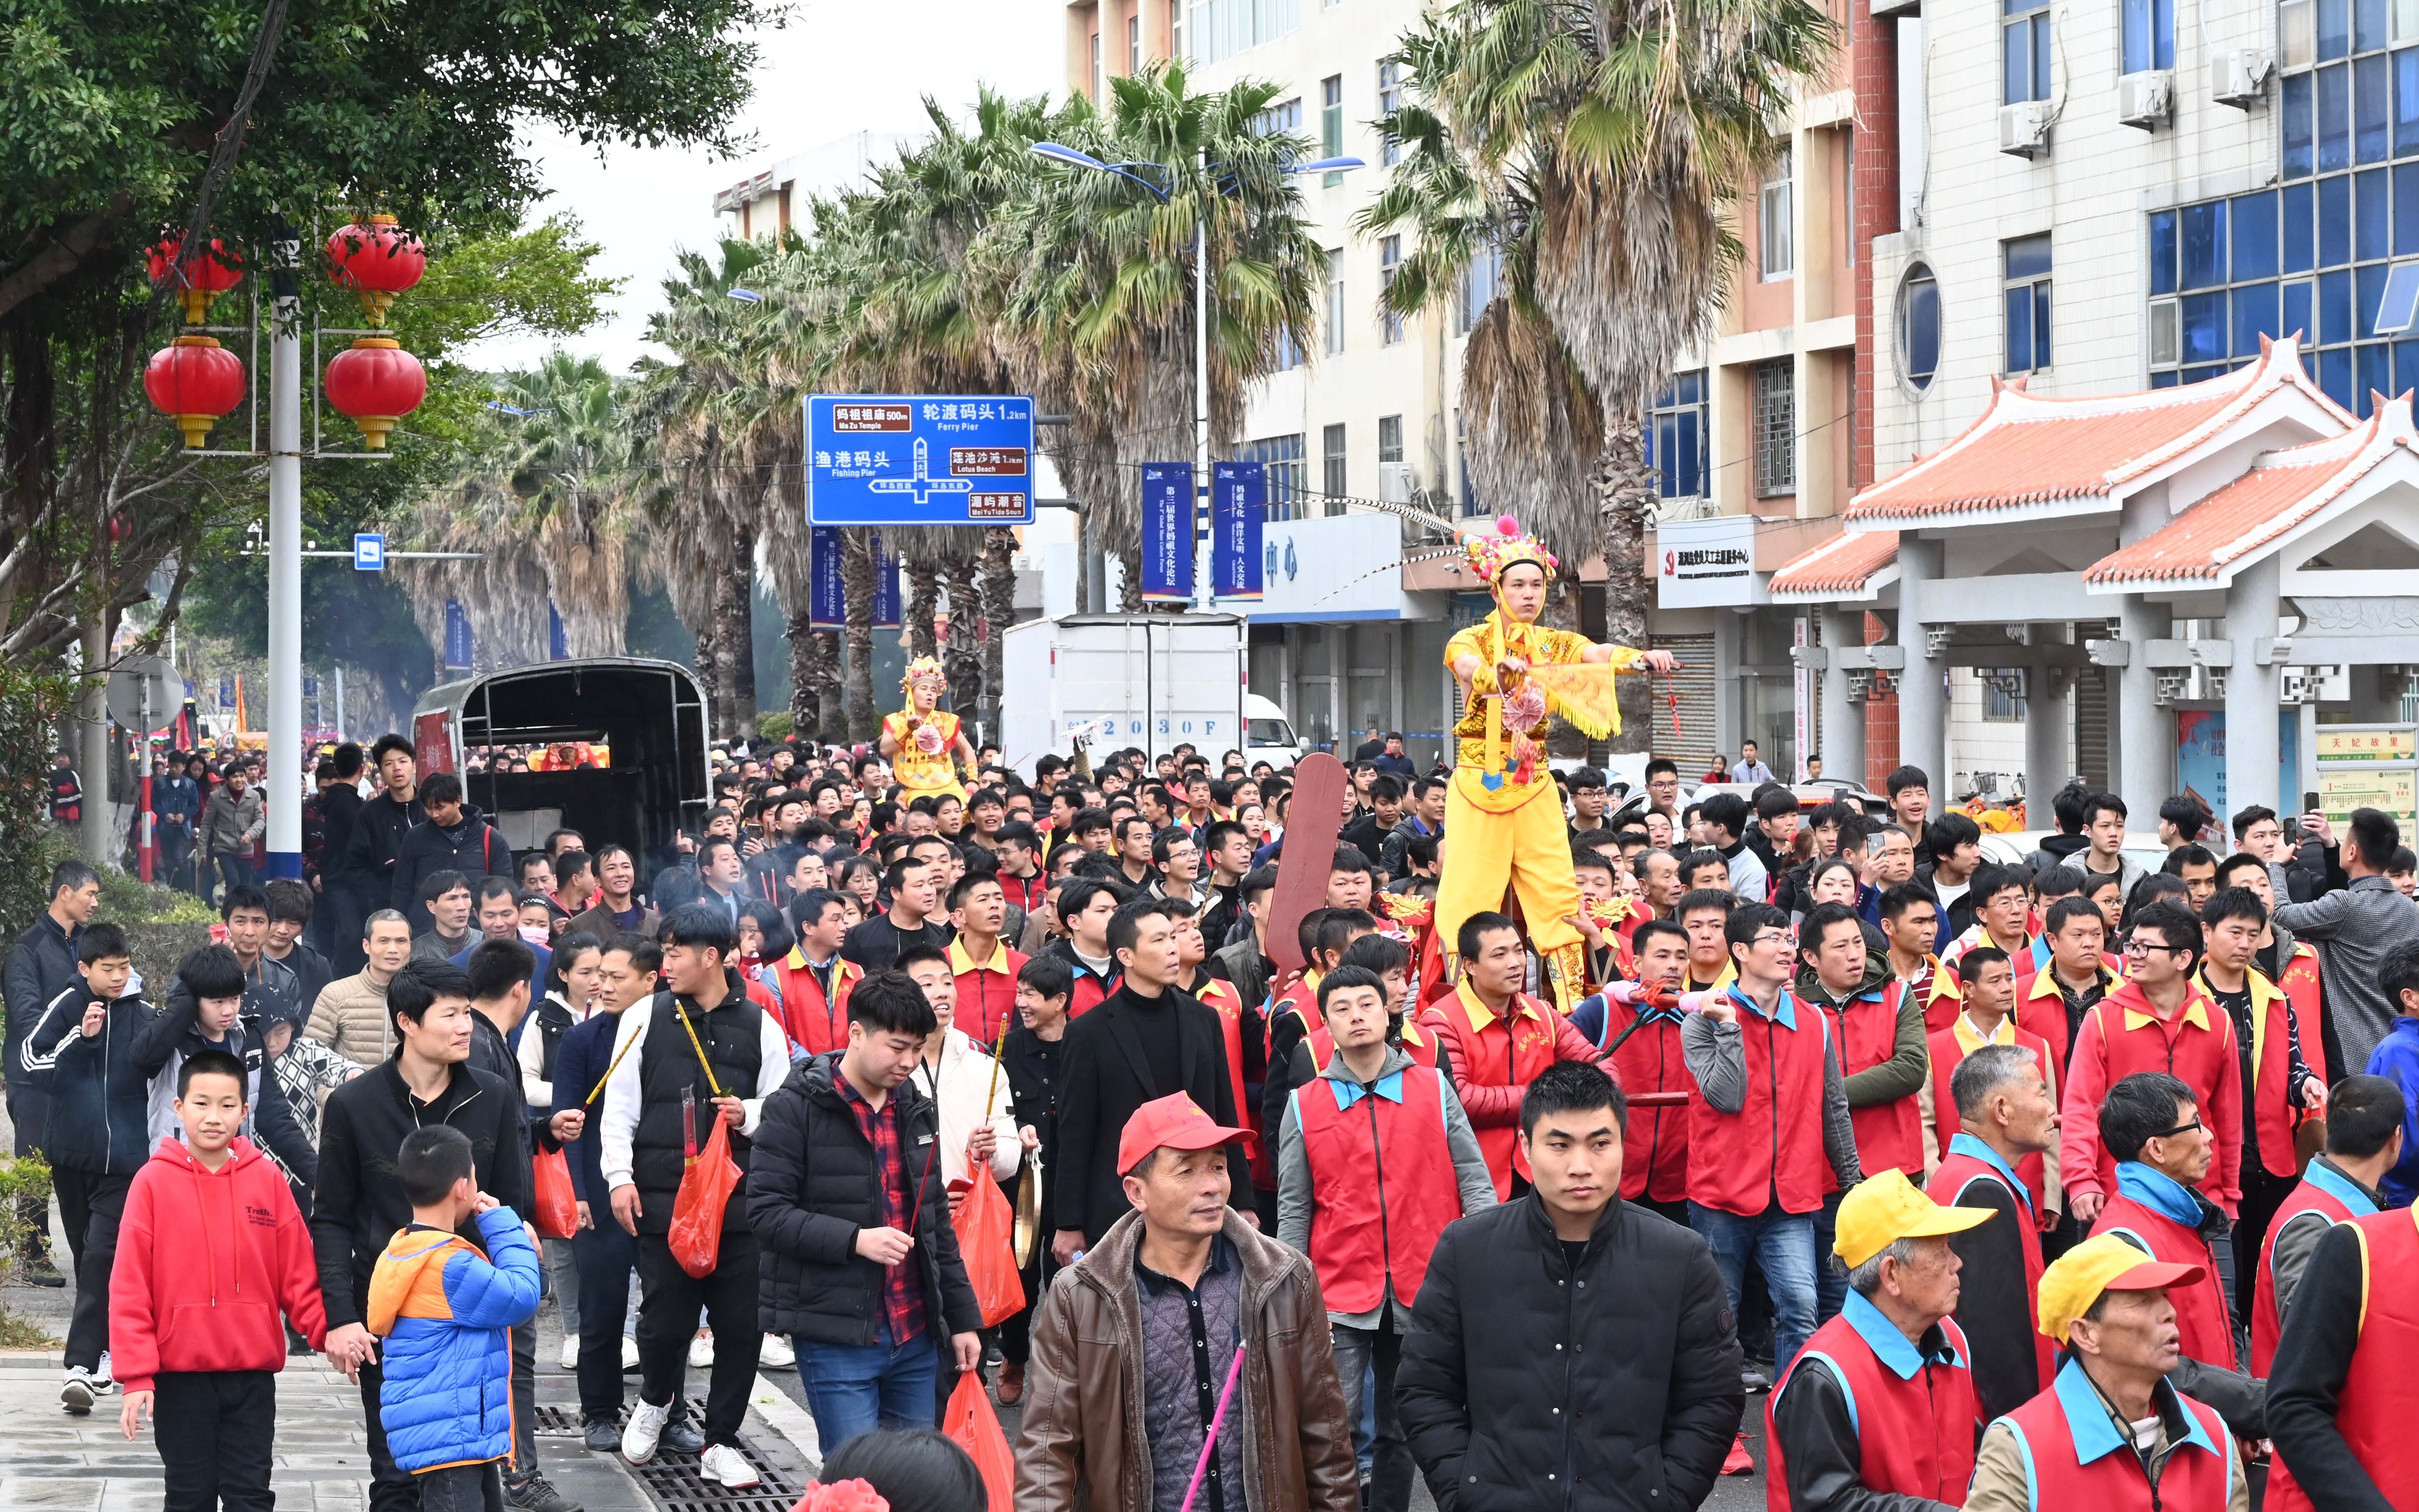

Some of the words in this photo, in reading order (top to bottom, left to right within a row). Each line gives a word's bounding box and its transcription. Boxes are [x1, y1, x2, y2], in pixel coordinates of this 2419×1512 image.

[836, 408, 885, 420] 妈祖祖庙
[886, 411, 908, 420] 500m
[923, 403, 995, 420] 轮渡码头
[998, 404, 1027, 420] 1.2km
[859, 422, 882, 430] Temple
[938, 423, 960, 432] Ferry
[962, 423, 978, 431] Pier
[815, 451, 890, 468] 渔港码头
[952, 452, 1000, 464] 莲池沙滩
[832, 469, 860, 479] Fishing
[861, 469, 876, 477] Pier
[971, 495, 1023, 508] 湄屿潮音
[1236, 484, 1245, 518] 妈祖文化
[1166, 486, 1176, 586] 第三届世界妈祖文化论坛
[1236, 520, 1245, 554] 海洋文明
[1236, 556, 1245, 589] 人文交流
[2332, 737, 2398, 748] 天妃故里
[2328, 783, 2332, 791] 1
[245, 1206, 273, 1216] Truth.
